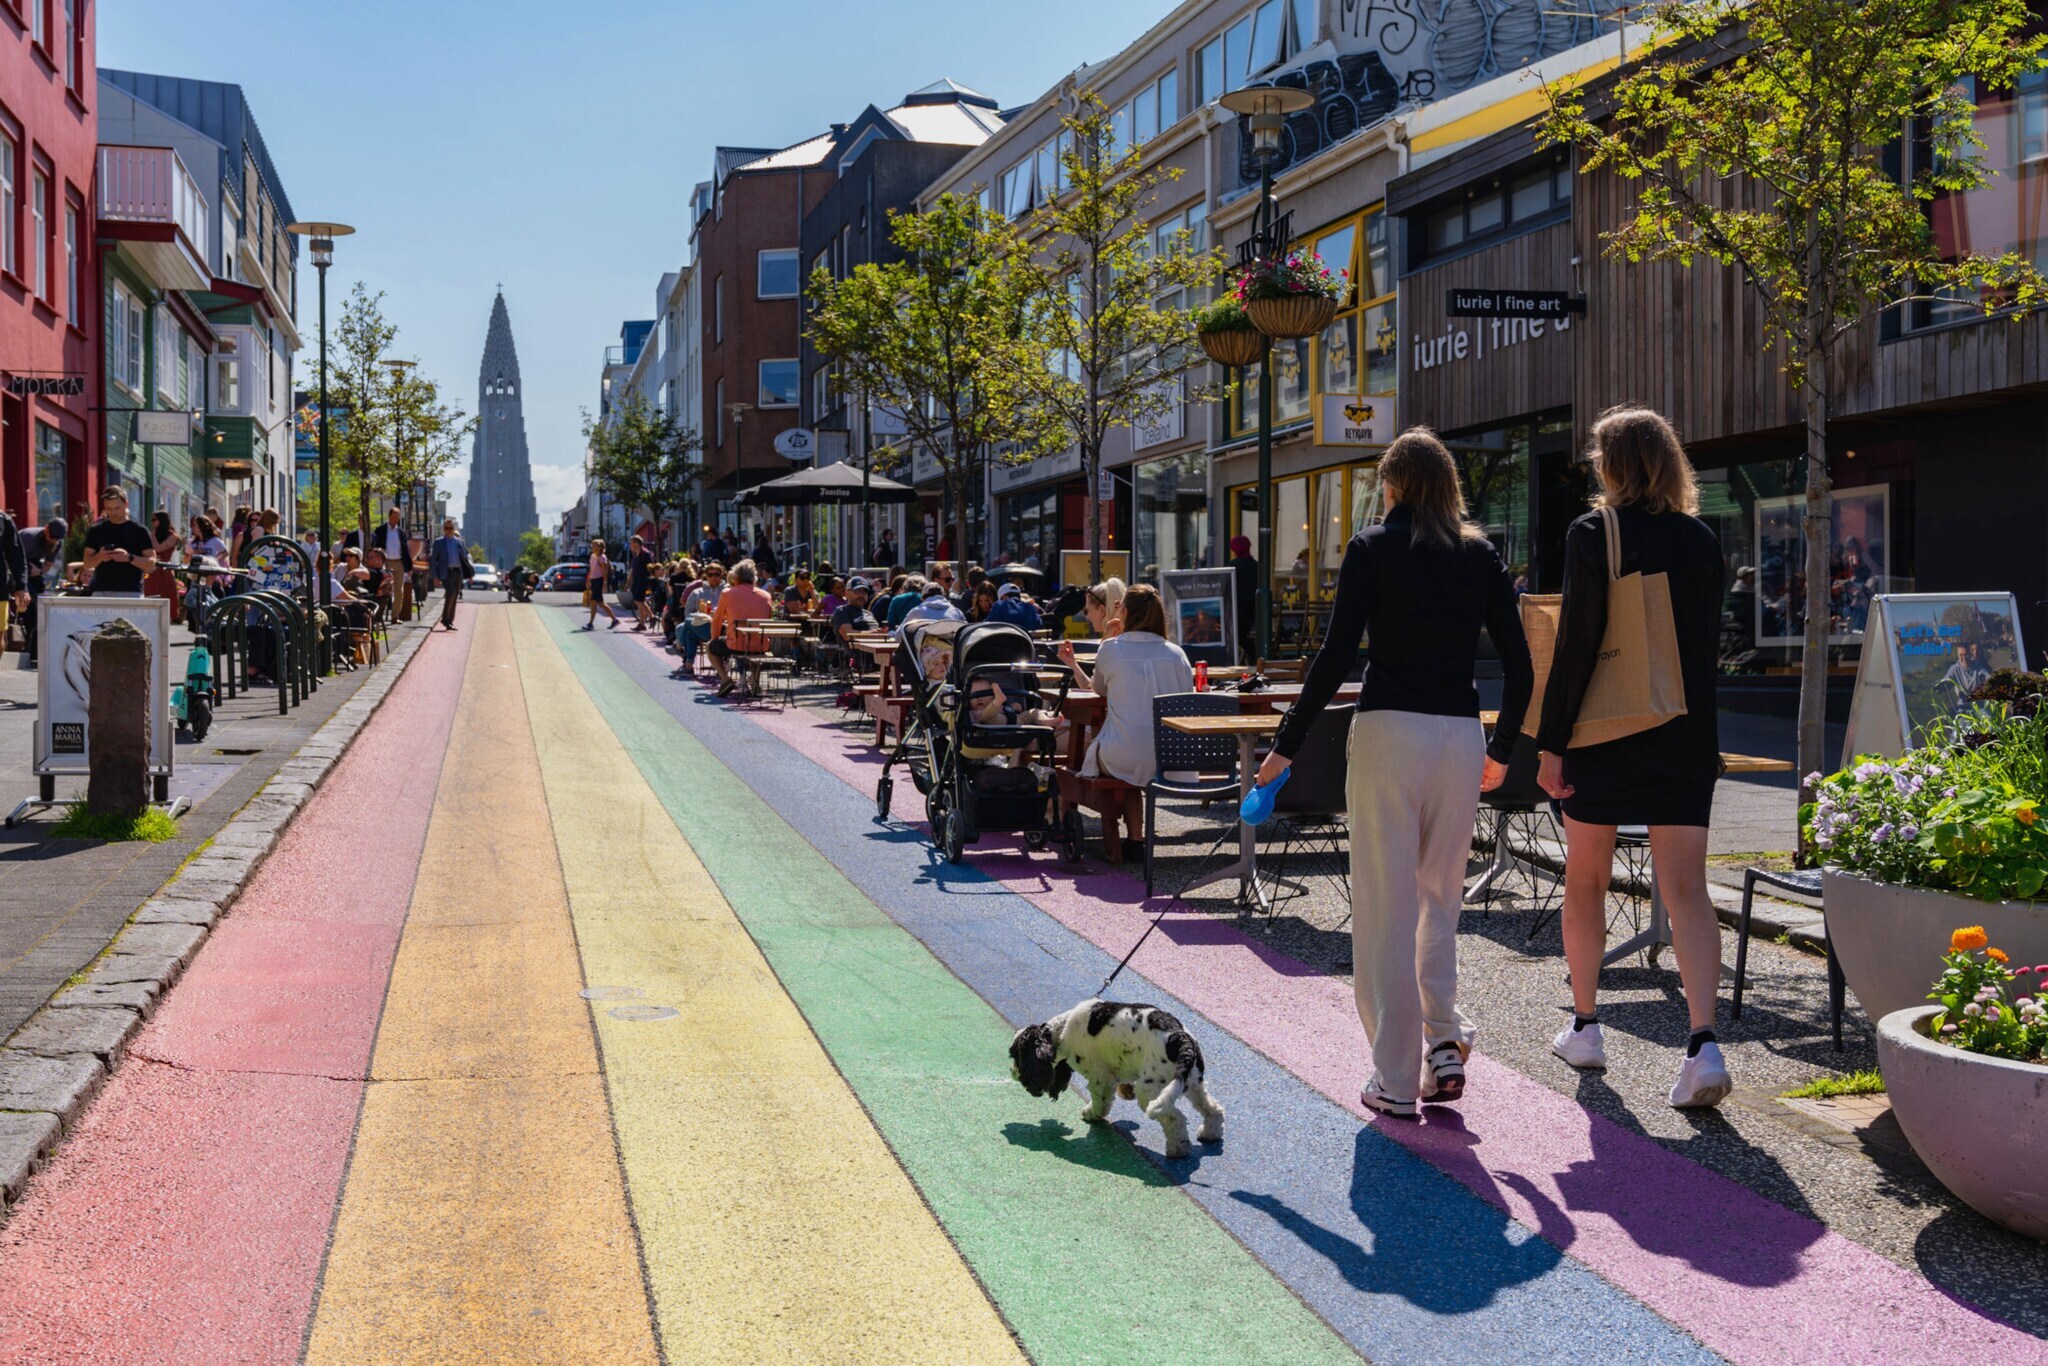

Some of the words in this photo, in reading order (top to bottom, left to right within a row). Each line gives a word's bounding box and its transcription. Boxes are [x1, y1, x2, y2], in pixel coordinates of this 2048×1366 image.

[1457, 294, 1491, 310] iurie
[1505, 296, 1535, 311] fine
[1539, 299, 1561, 311] art
[1414, 323, 1469, 371] iurie
[10, 376, 84, 397] MOKKA
[143, 421, 184, 432] Kaolin
[1900, 623, 1934, 637] Let's
[55, 725, 81, 733] ANNA
[54, 733, 81, 741] MARIA
